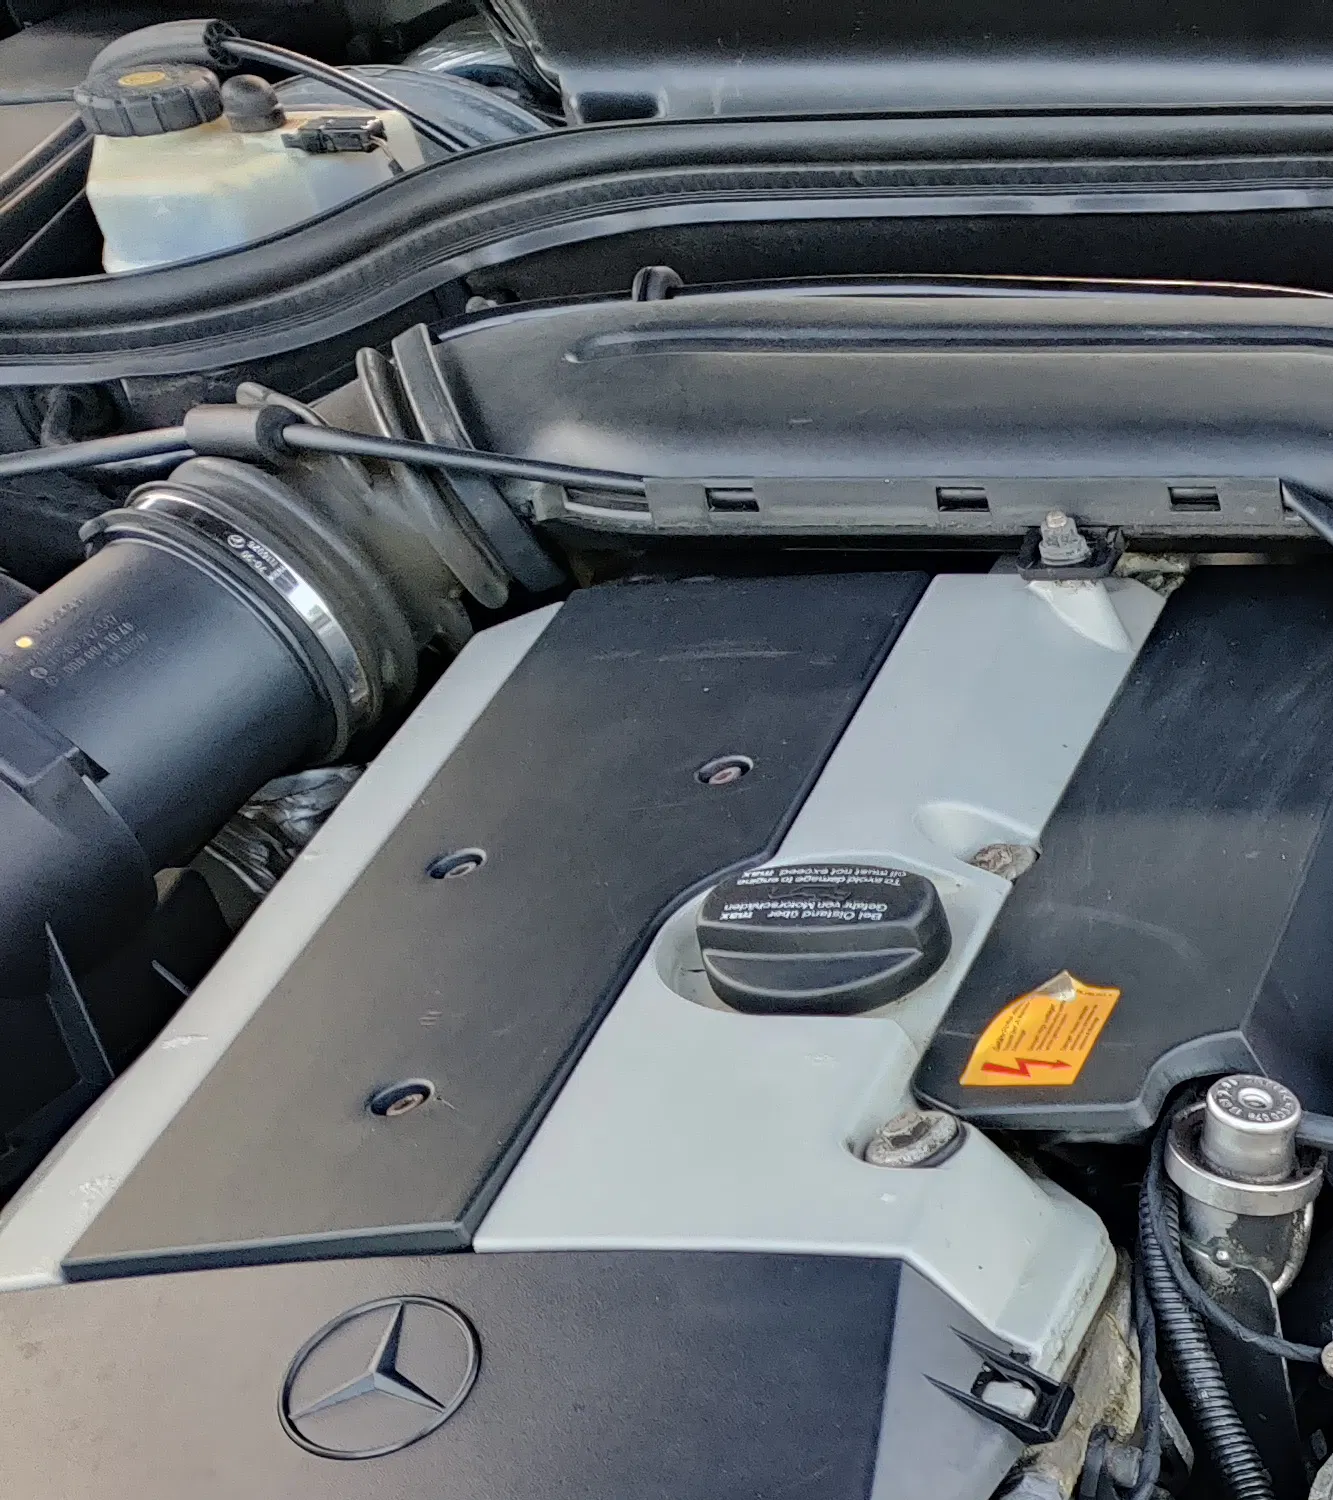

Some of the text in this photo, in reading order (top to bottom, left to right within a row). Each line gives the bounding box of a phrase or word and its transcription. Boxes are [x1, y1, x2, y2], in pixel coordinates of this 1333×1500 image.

[737, 877, 780, 886] engine
[781, 876, 794, 884] to
[795, 876, 846, 884] damage
[846, 876, 884, 885] avoid
[843, 902, 888, 912] Gefahr
